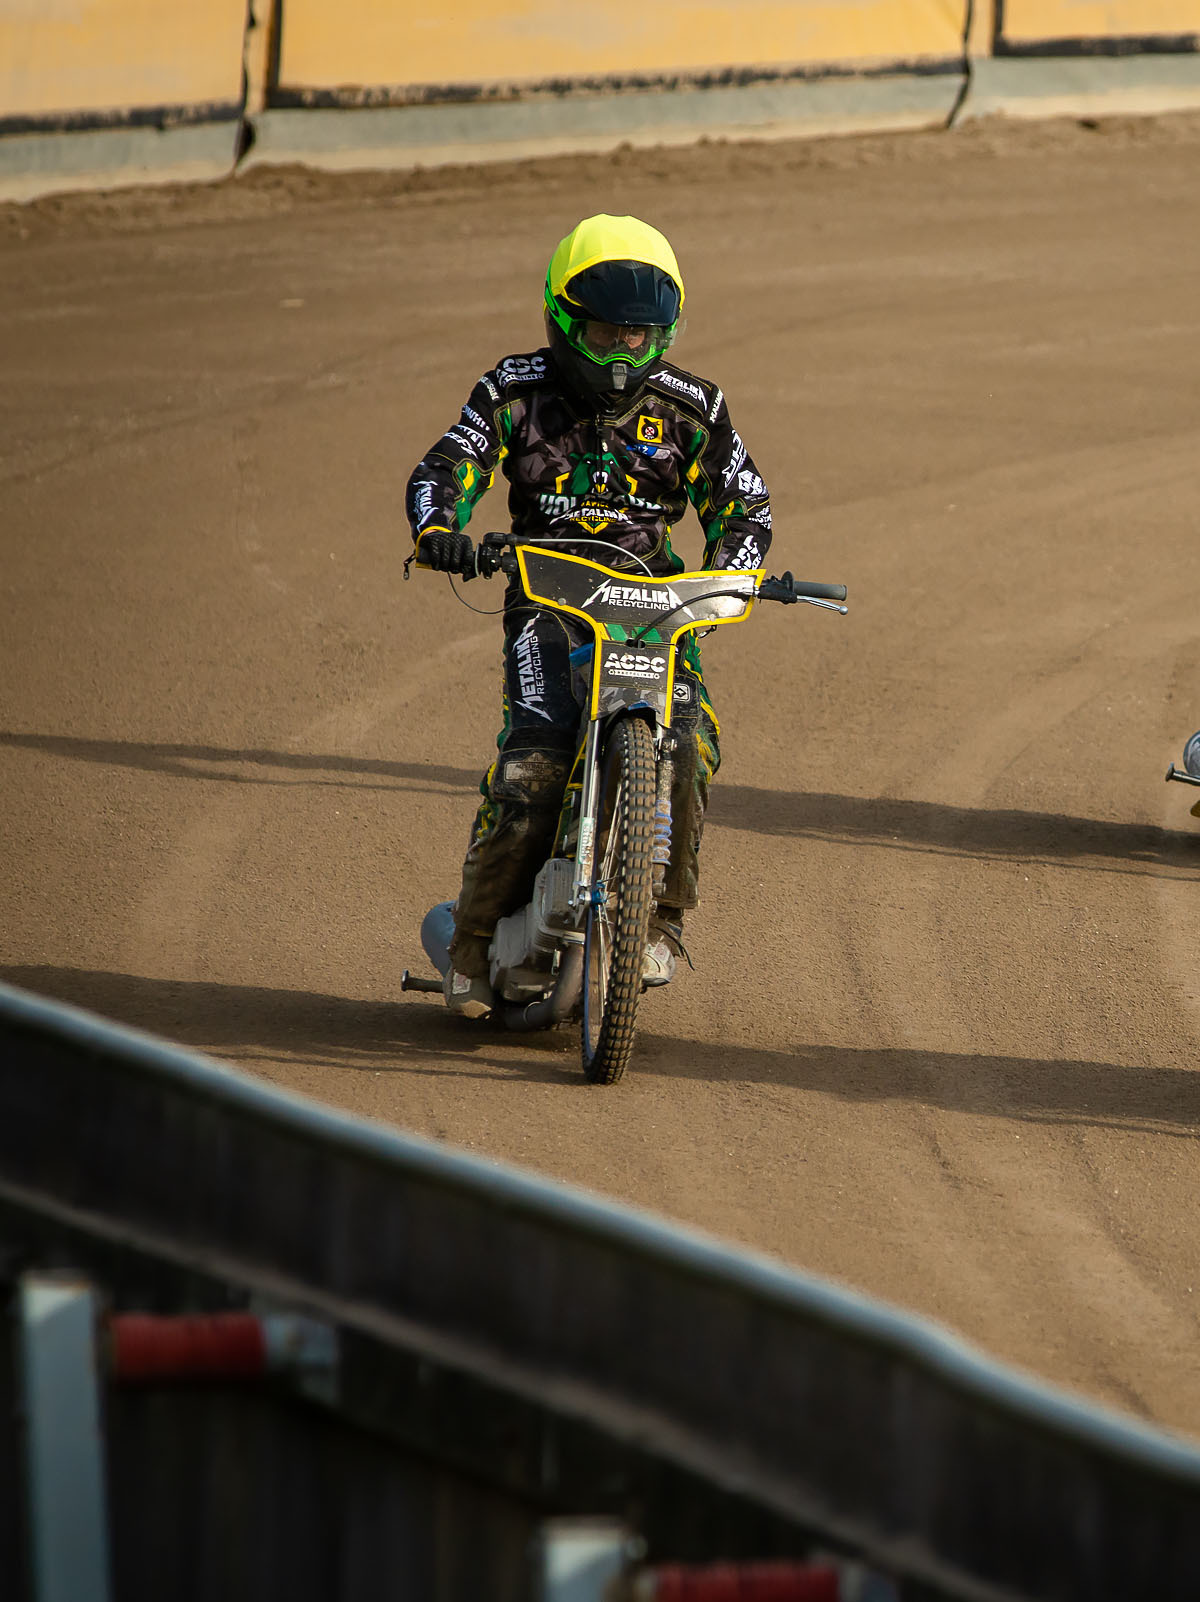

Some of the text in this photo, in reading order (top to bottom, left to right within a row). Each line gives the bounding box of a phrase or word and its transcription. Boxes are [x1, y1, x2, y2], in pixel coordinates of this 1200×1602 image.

[581, 578, 696, 621] METALIKA
[608, 599, 671, 612] RECYCLING
[513, 612, 554, 723] METALIKA
[533, 634, 547, 696] RECYCLING
[604, 652, 666, 673] ACDC
